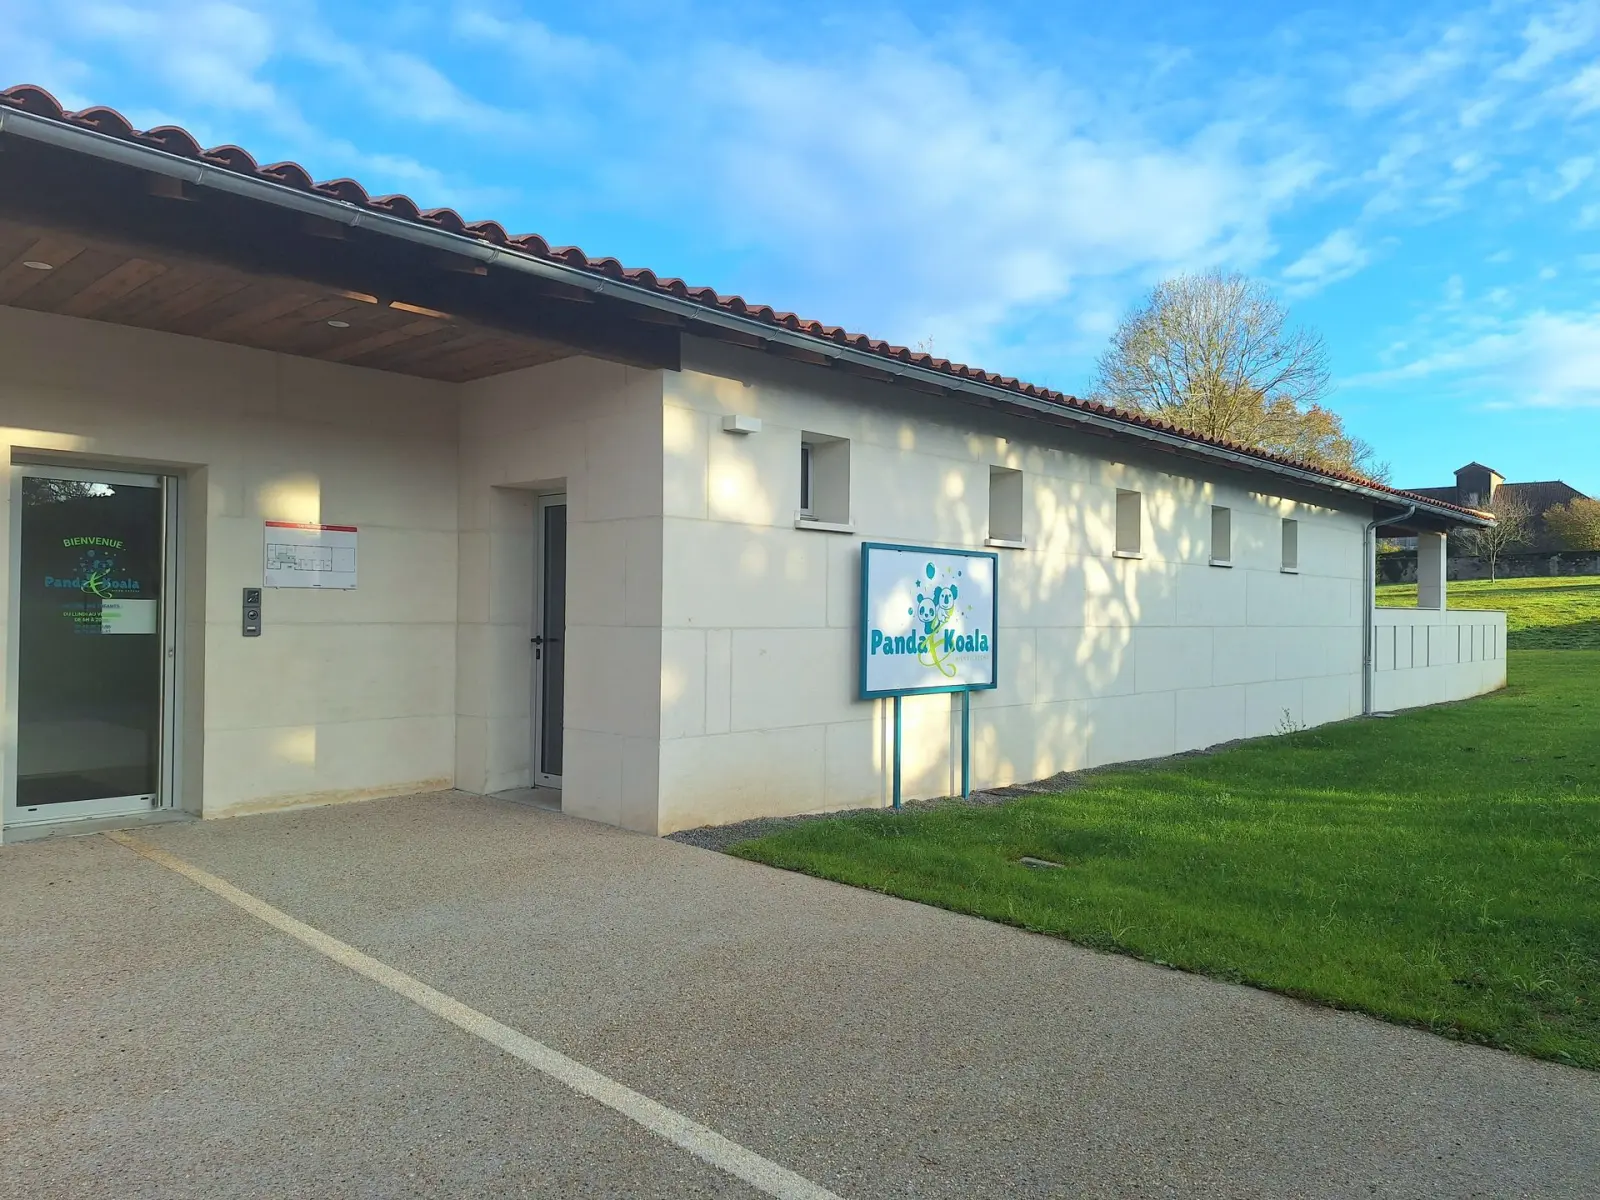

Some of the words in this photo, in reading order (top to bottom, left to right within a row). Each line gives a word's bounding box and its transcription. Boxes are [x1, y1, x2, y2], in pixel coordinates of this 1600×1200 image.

[63, 536, 124, 550] BIENVENUE
[44, 576, 89, 590] Panda
[870, 629, 928, 655] Panda
[943, 628, 989, 653] Koala
